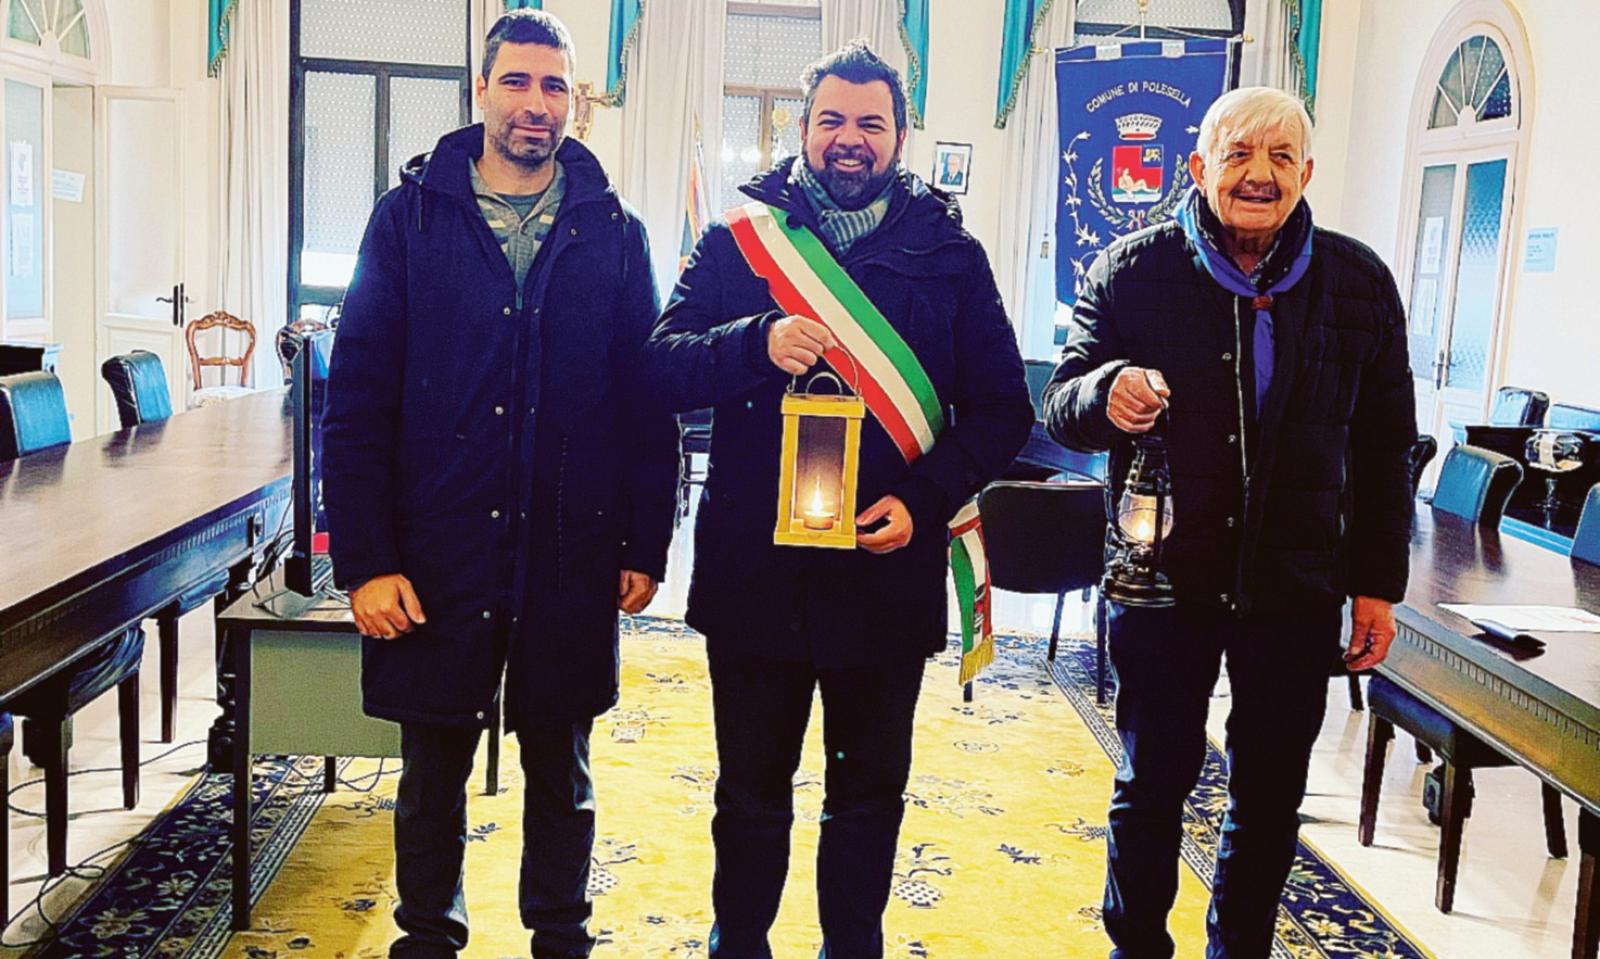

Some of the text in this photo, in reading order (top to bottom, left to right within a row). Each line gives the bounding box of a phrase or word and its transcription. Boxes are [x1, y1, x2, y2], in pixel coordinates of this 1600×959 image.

[1086, 80, 1192, 112] COMUNE DI POLESELLA
